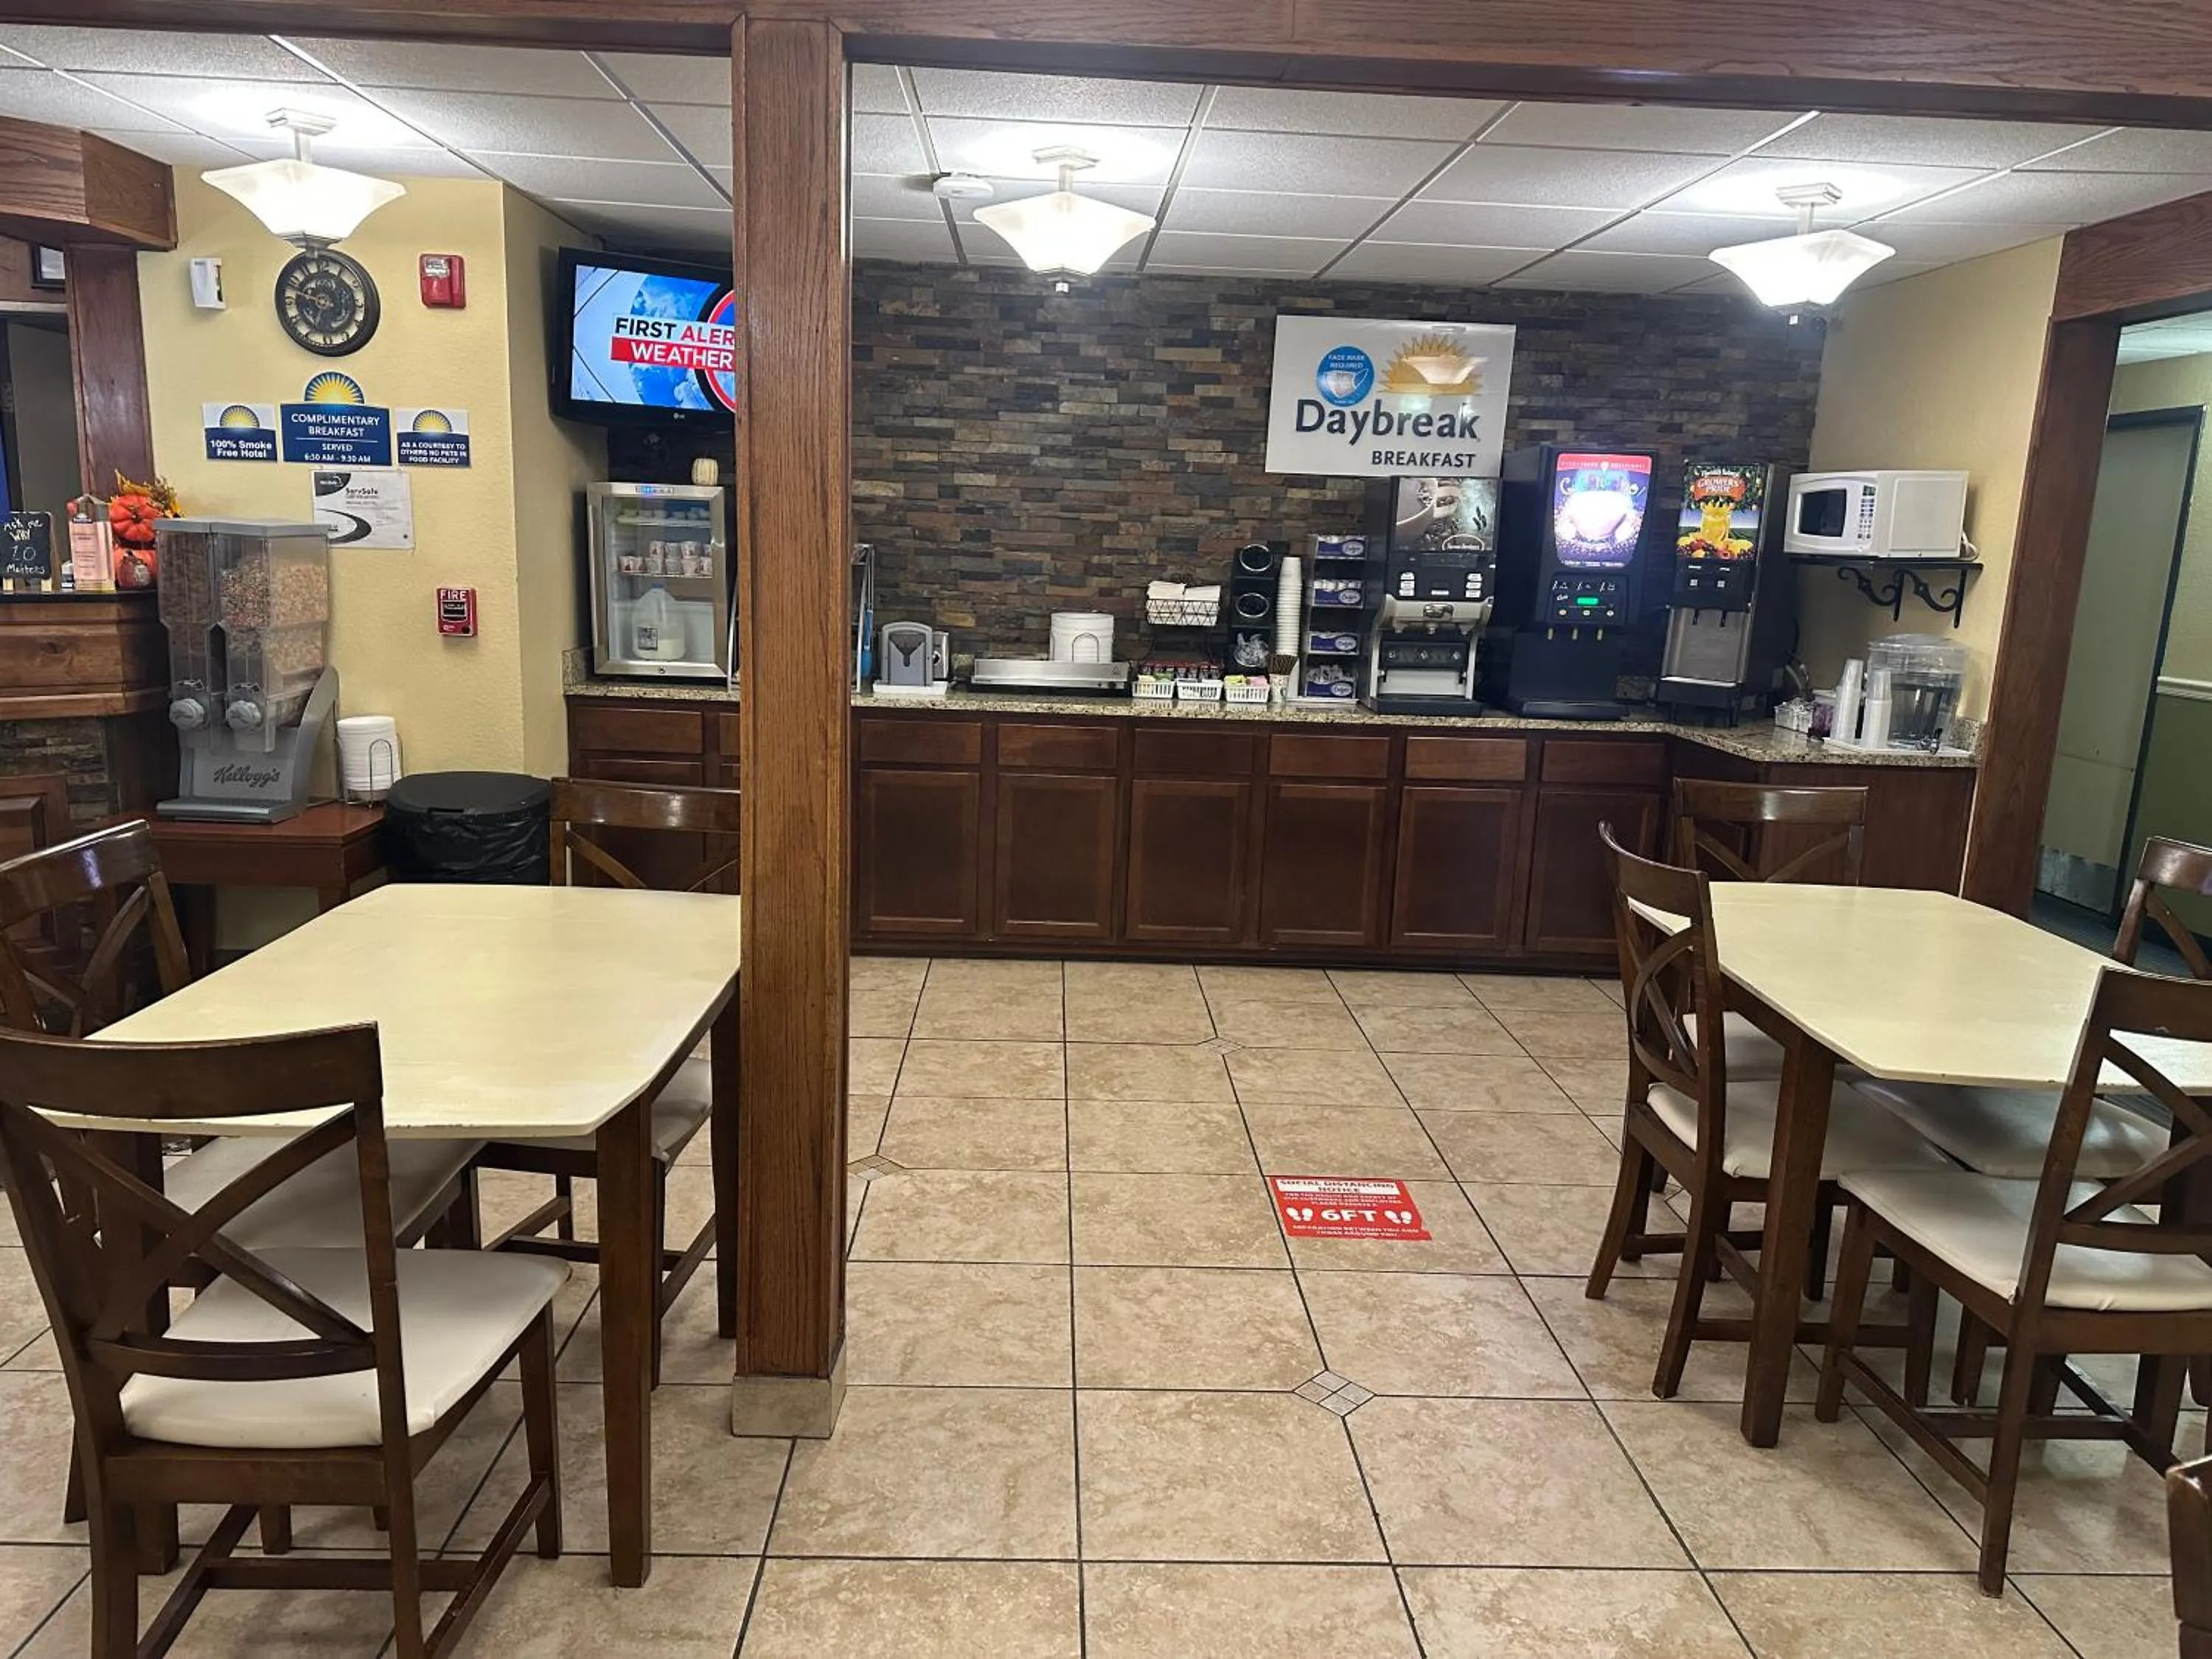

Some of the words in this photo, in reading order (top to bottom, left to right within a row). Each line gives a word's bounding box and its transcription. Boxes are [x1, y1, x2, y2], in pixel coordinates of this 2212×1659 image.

[615, 317, 677, 339] FIRST
[681, 325, 734, 346] ALER
[631, 341, 734, 369] WEATHER
[291, 413, 380, 426] COMPLIMENTARY
[1295, 399, 1480, 445] Daybreak
[308, 425, 365, 437] BREAKFAST
[210, 439, 237, 449] 100%
[239, 440, 272, 450] Smoke
[322, 443, 353, 451] SERVED
[217, 448, 238, 457] Free
[241, 449, 267, 459] Hotel
[305, 452, 321, 461] 6:30
[321, 453, 334, 462] AM
[358, 455, 372, 463] AM
[1371, 451, 1476, 468] BREAKFAST
[440, 589, 467, 602] FIRE
[213, 763, 280, 788] Kellogg's
[1321, 1209, 1377, 1222] 6FT
